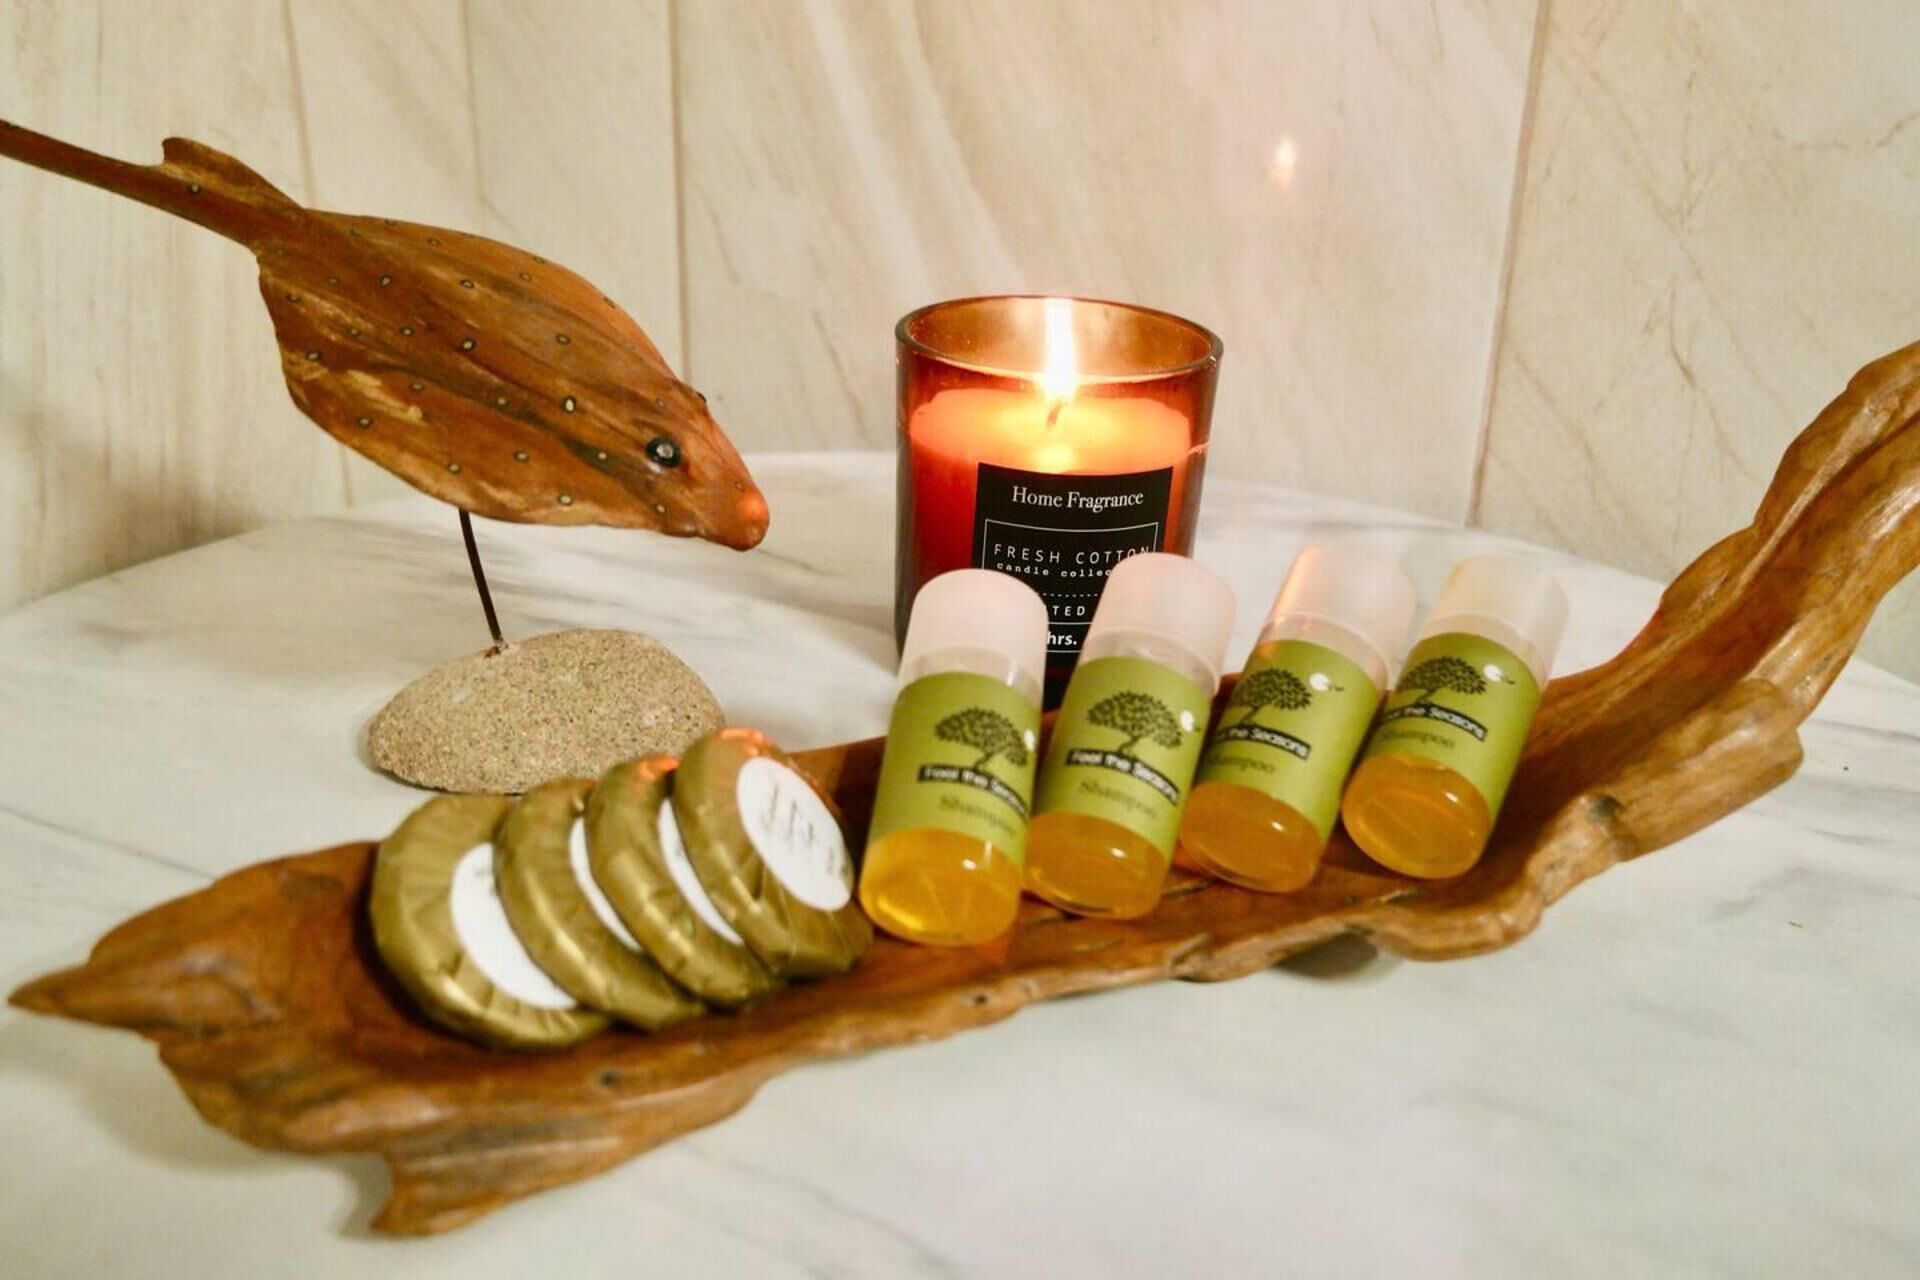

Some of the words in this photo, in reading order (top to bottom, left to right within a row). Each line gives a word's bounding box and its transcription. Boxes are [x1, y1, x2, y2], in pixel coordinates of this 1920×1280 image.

[1012, 485, 1063, 507] Home
[1066, 491, 1144, 513] Fragrance
[994, 543, 1060, 563] FRESH
[996, 563, 1049, 576] candle
[1060, 569, 1112, 577] collec
[1047, 631, 1078, 646] hrs.
